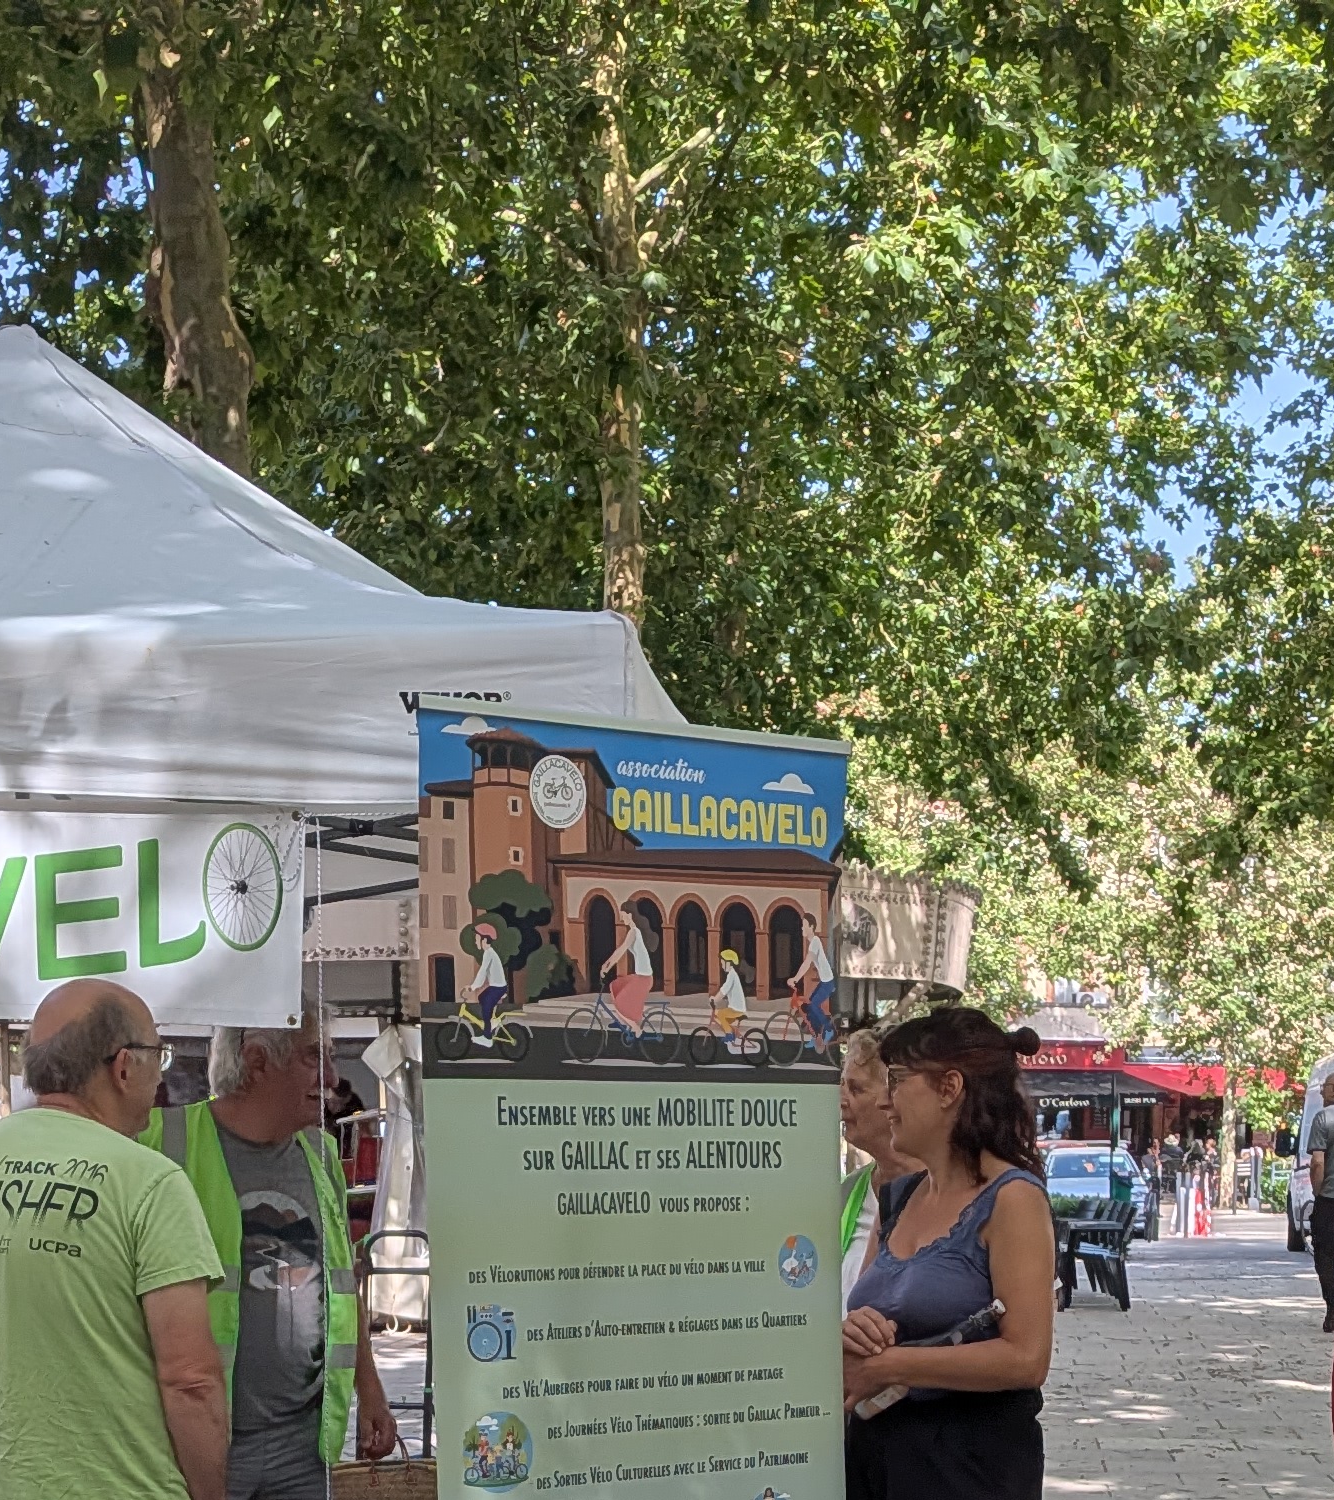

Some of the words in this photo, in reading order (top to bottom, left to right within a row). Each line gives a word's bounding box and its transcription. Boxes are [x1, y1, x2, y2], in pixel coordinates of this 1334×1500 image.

[617, 758, 706, 784] association
[612, 786, 827, 848] GAILLACAVELO
[497, 1096, 577, 1126] ENSEMBLE
[582, 1106, 615, 1126] VERS
[622, 1107, 651, 1127] UNE
[657, 1098, 735, 1127] MOBILITE
[741, 1098, 798, 1127] DOUCE
[1039, 1096, 1090, 1108] O'Carlow
[523, 1150, 555, 1170] SUR
[561, 1141, 629, 1170] GAILLAC
[635, 1150, 651, 1169] ET
[657, 1149, 681, 1169] SES
[685, 1141, 783, 1169] ALENTOURS
[4, 1160, 59, 1176] TRACK
[61, 1158, 109, 1185] 2016
[557, 1191, 651, 1215] GAILLACAVELO
[659, 1197, 689, 1213] VOUS
[693, 1195, 741, 1212] PROPOSE
[468, 1271, 487, 1284] DES
[489, 1265, 556, 1284] VÉLORUTIONS
[558, 1267, 581, 1281] POUR
[583, 1261, 625, 1279] DÉFENDRE
[628, 1264, 638, 1277] LA
[641, 1263, 666, 1276] PLACE
[669, 1263, 682, 1275] DU
[684, 1257, 704, 1275] VÉLO
[707, 1261, 729, 1274] DANS
[732, 1261, 741, 1273] LA
[744, 1260, 766, 1272] VILLE
[527, 1329, 544, 1342] DES
[546, 1323, 582, 1341] ATELIERS
[585, 1320, 666, 1338] D'AUTO-ENTRETIEN
[668, 1321, 675, 1333] &
[678, 1316, 719, 1333] RÉGLAGES
[721, 1317, 743, 1330] DANS
[745, 1317, 759, 1329] LES
[761, 1311, 807, 1328] QUARTIERS
[502, 1386, 520, 1399] DES
[523, 1379, 585, 1398] VÉL'AUBERGES
[587, 1380, 612, 1392] POUR
[615, 1377, 639, 1391] FAIRE
[642, 1376, 655, 1389] DU
[657, 1371, 678, 1387] VÉLO
[681, 1373, 694, 1386] UN
[696, 1371, 732, 1385] MOMENT
[735, 1370, 745, 1382] DE
[747, 1367, 784, 1381] PARTAGE
[548, 1427, 562, 1439] DES
[564, 1418, 607, 1438] JOURNÉES
[610, 1416, 632, 1434] VÉLO
[635, 1413, 693, 1431] THÉMATIQUES
[703, 1412, 730, 1425] SORTIE
[733, 1411, 745, 1423] DU
[747, 1405, 781, 1422] GAILLAC
[784, 1403, 820, 1419] PRIMEUR
[536, 1477, 551, 1490] DES
[554, 1470, 587, 1488] SORTIES
[590, 1466, 613, 1483] VÉLO
[616, 1464, 671, 1481] CULTURELLES
[673, 1462, 695, 1476] AVEC
[697, 1461, 706, 1474] LE
[709, 1455, 741, 1473] SERVICE
[744, 1456, 756, 1469] DU
[758, 1451, 809, 1467] PATRIMOINE
